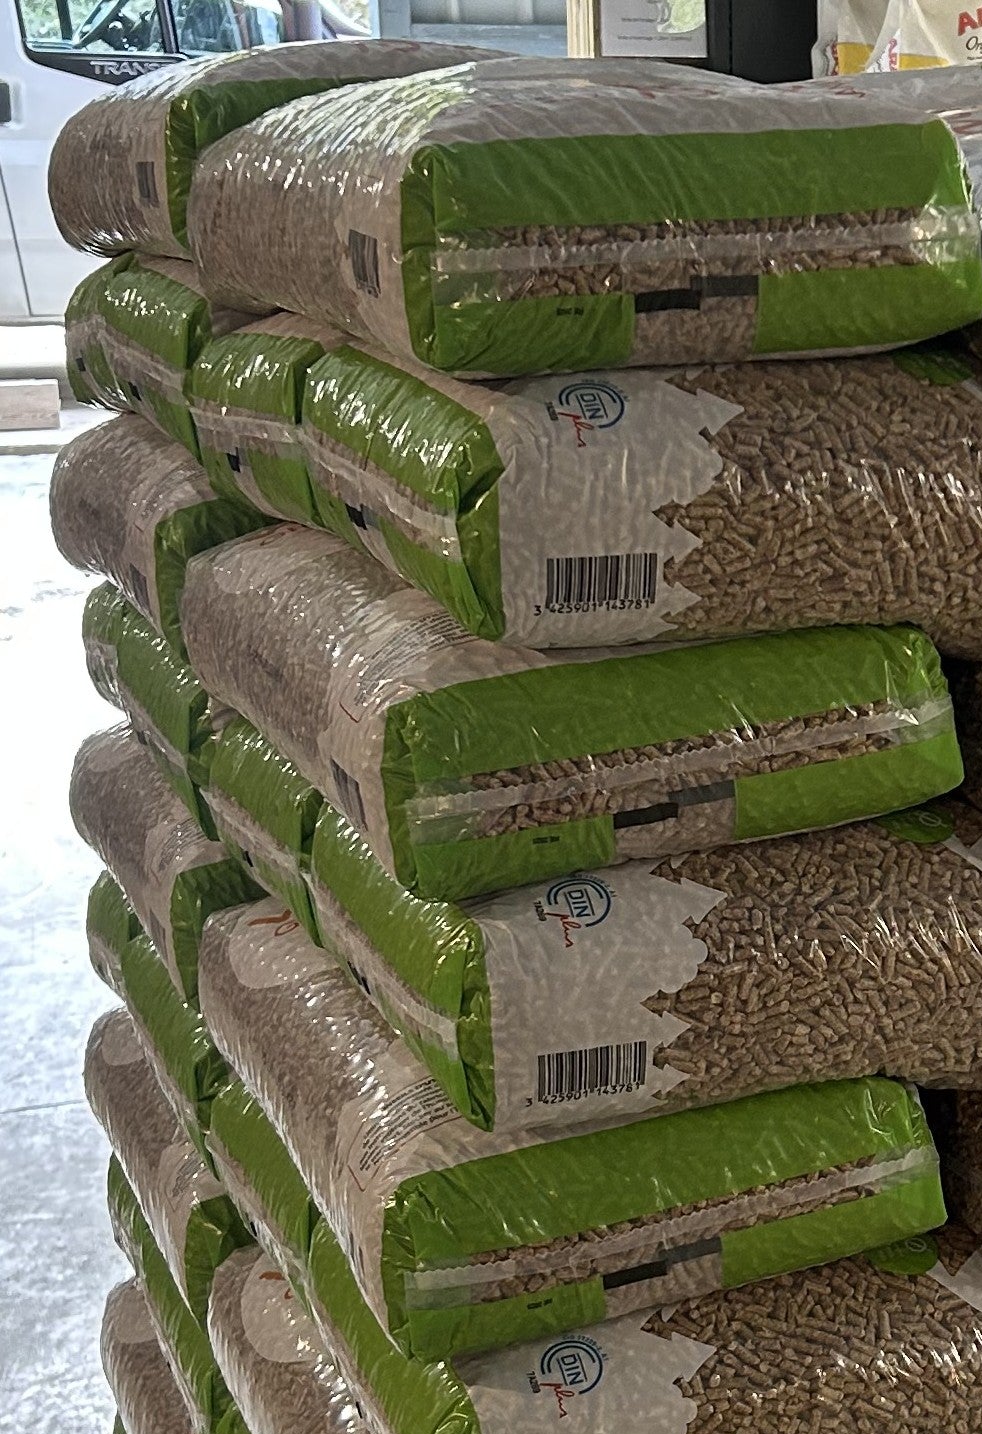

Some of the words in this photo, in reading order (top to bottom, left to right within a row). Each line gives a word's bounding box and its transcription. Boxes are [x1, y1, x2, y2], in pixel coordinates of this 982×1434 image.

[580, 393, 604, 420] DIN
[557, 411, 596, 448] plus
[534, 605, 542, 616] 3
[549, 602, 597, 613] 425901
[605, 599, 649, 611] 143781
[567, 889, 591, 918] DIN
[545, 912, 582, 948] plus
[525, 1097, 533, 1107] 3
[561, 1353, 584, 1386] DIN
[540, 1381, 575, 1419] plus
